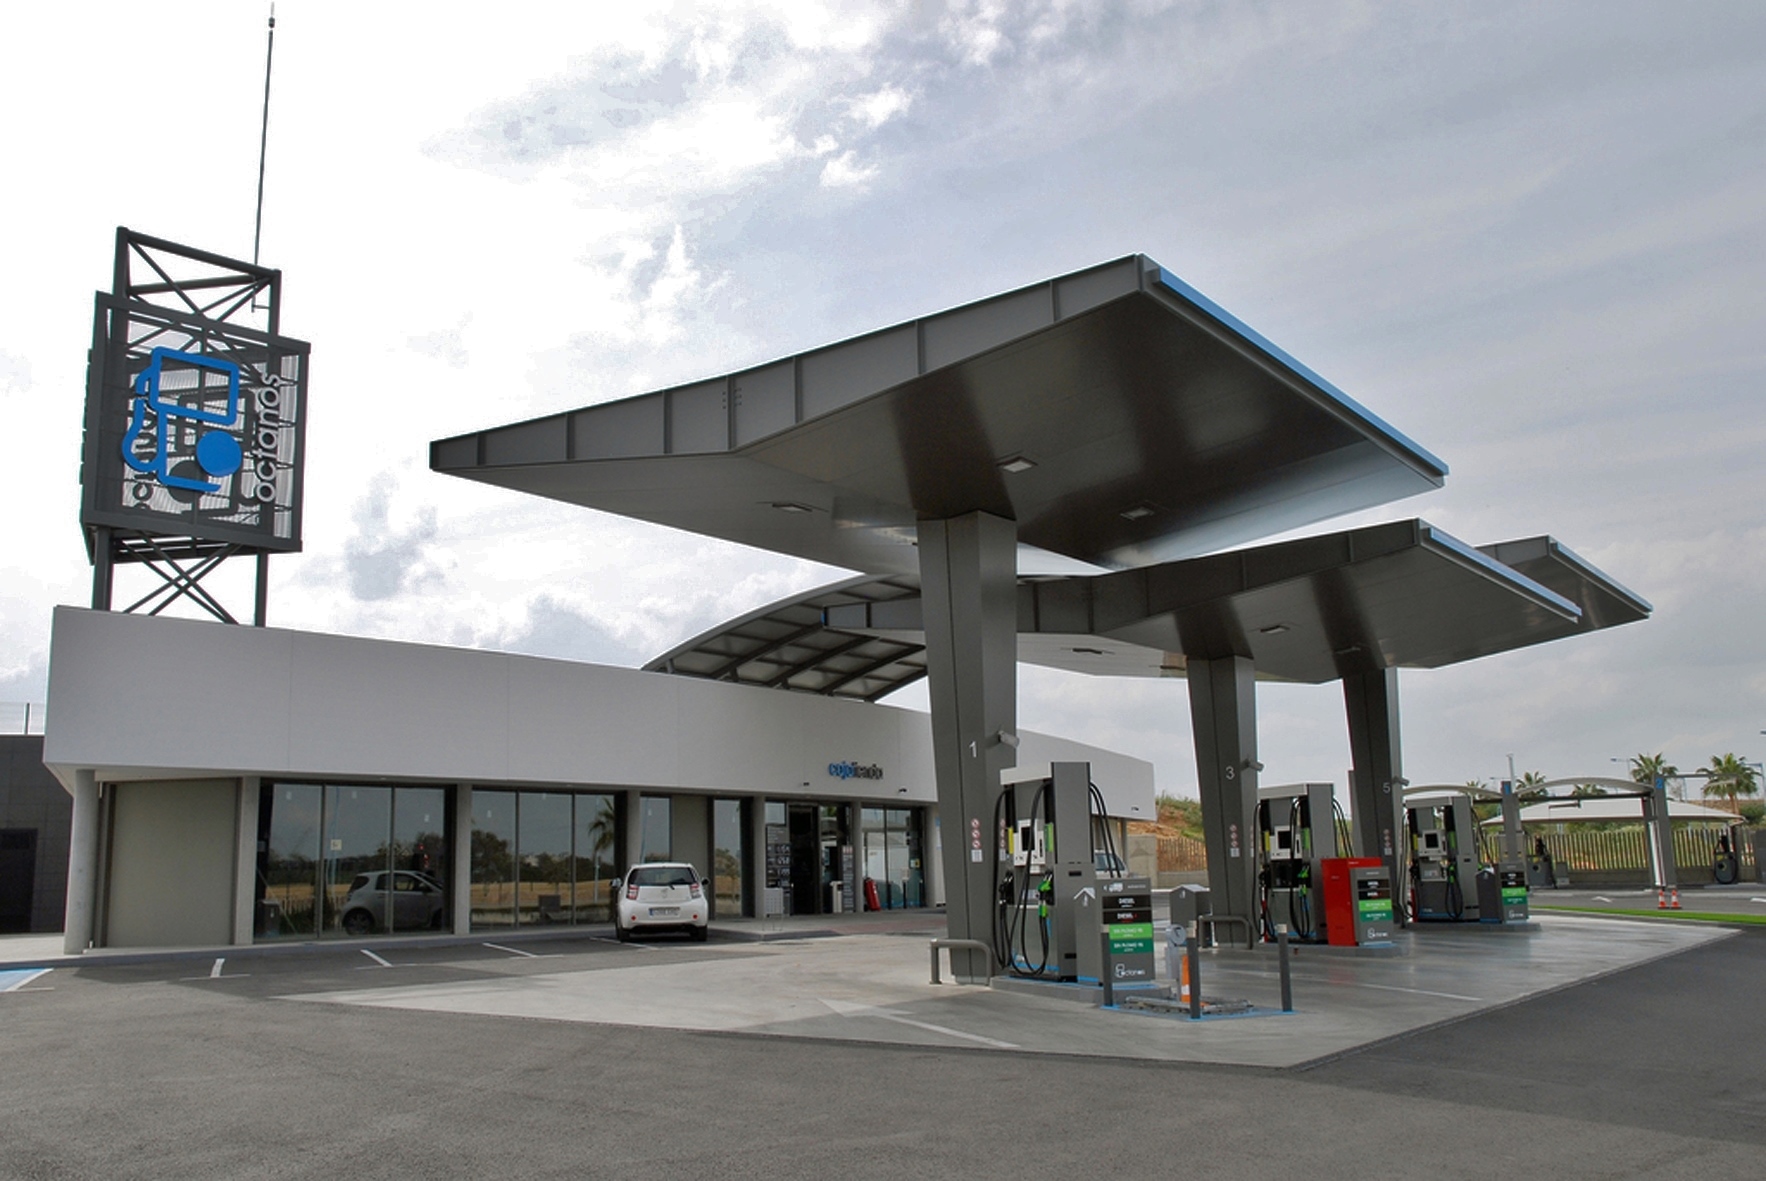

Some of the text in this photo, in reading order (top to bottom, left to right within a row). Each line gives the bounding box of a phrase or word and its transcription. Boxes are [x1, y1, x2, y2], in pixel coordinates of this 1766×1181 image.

[252, 374, 281, 502] octanos
[969, 741, 977, 758] 1
[1226, 766, 1235, 780] 3
[1383, 782, 1391, 794] 5
